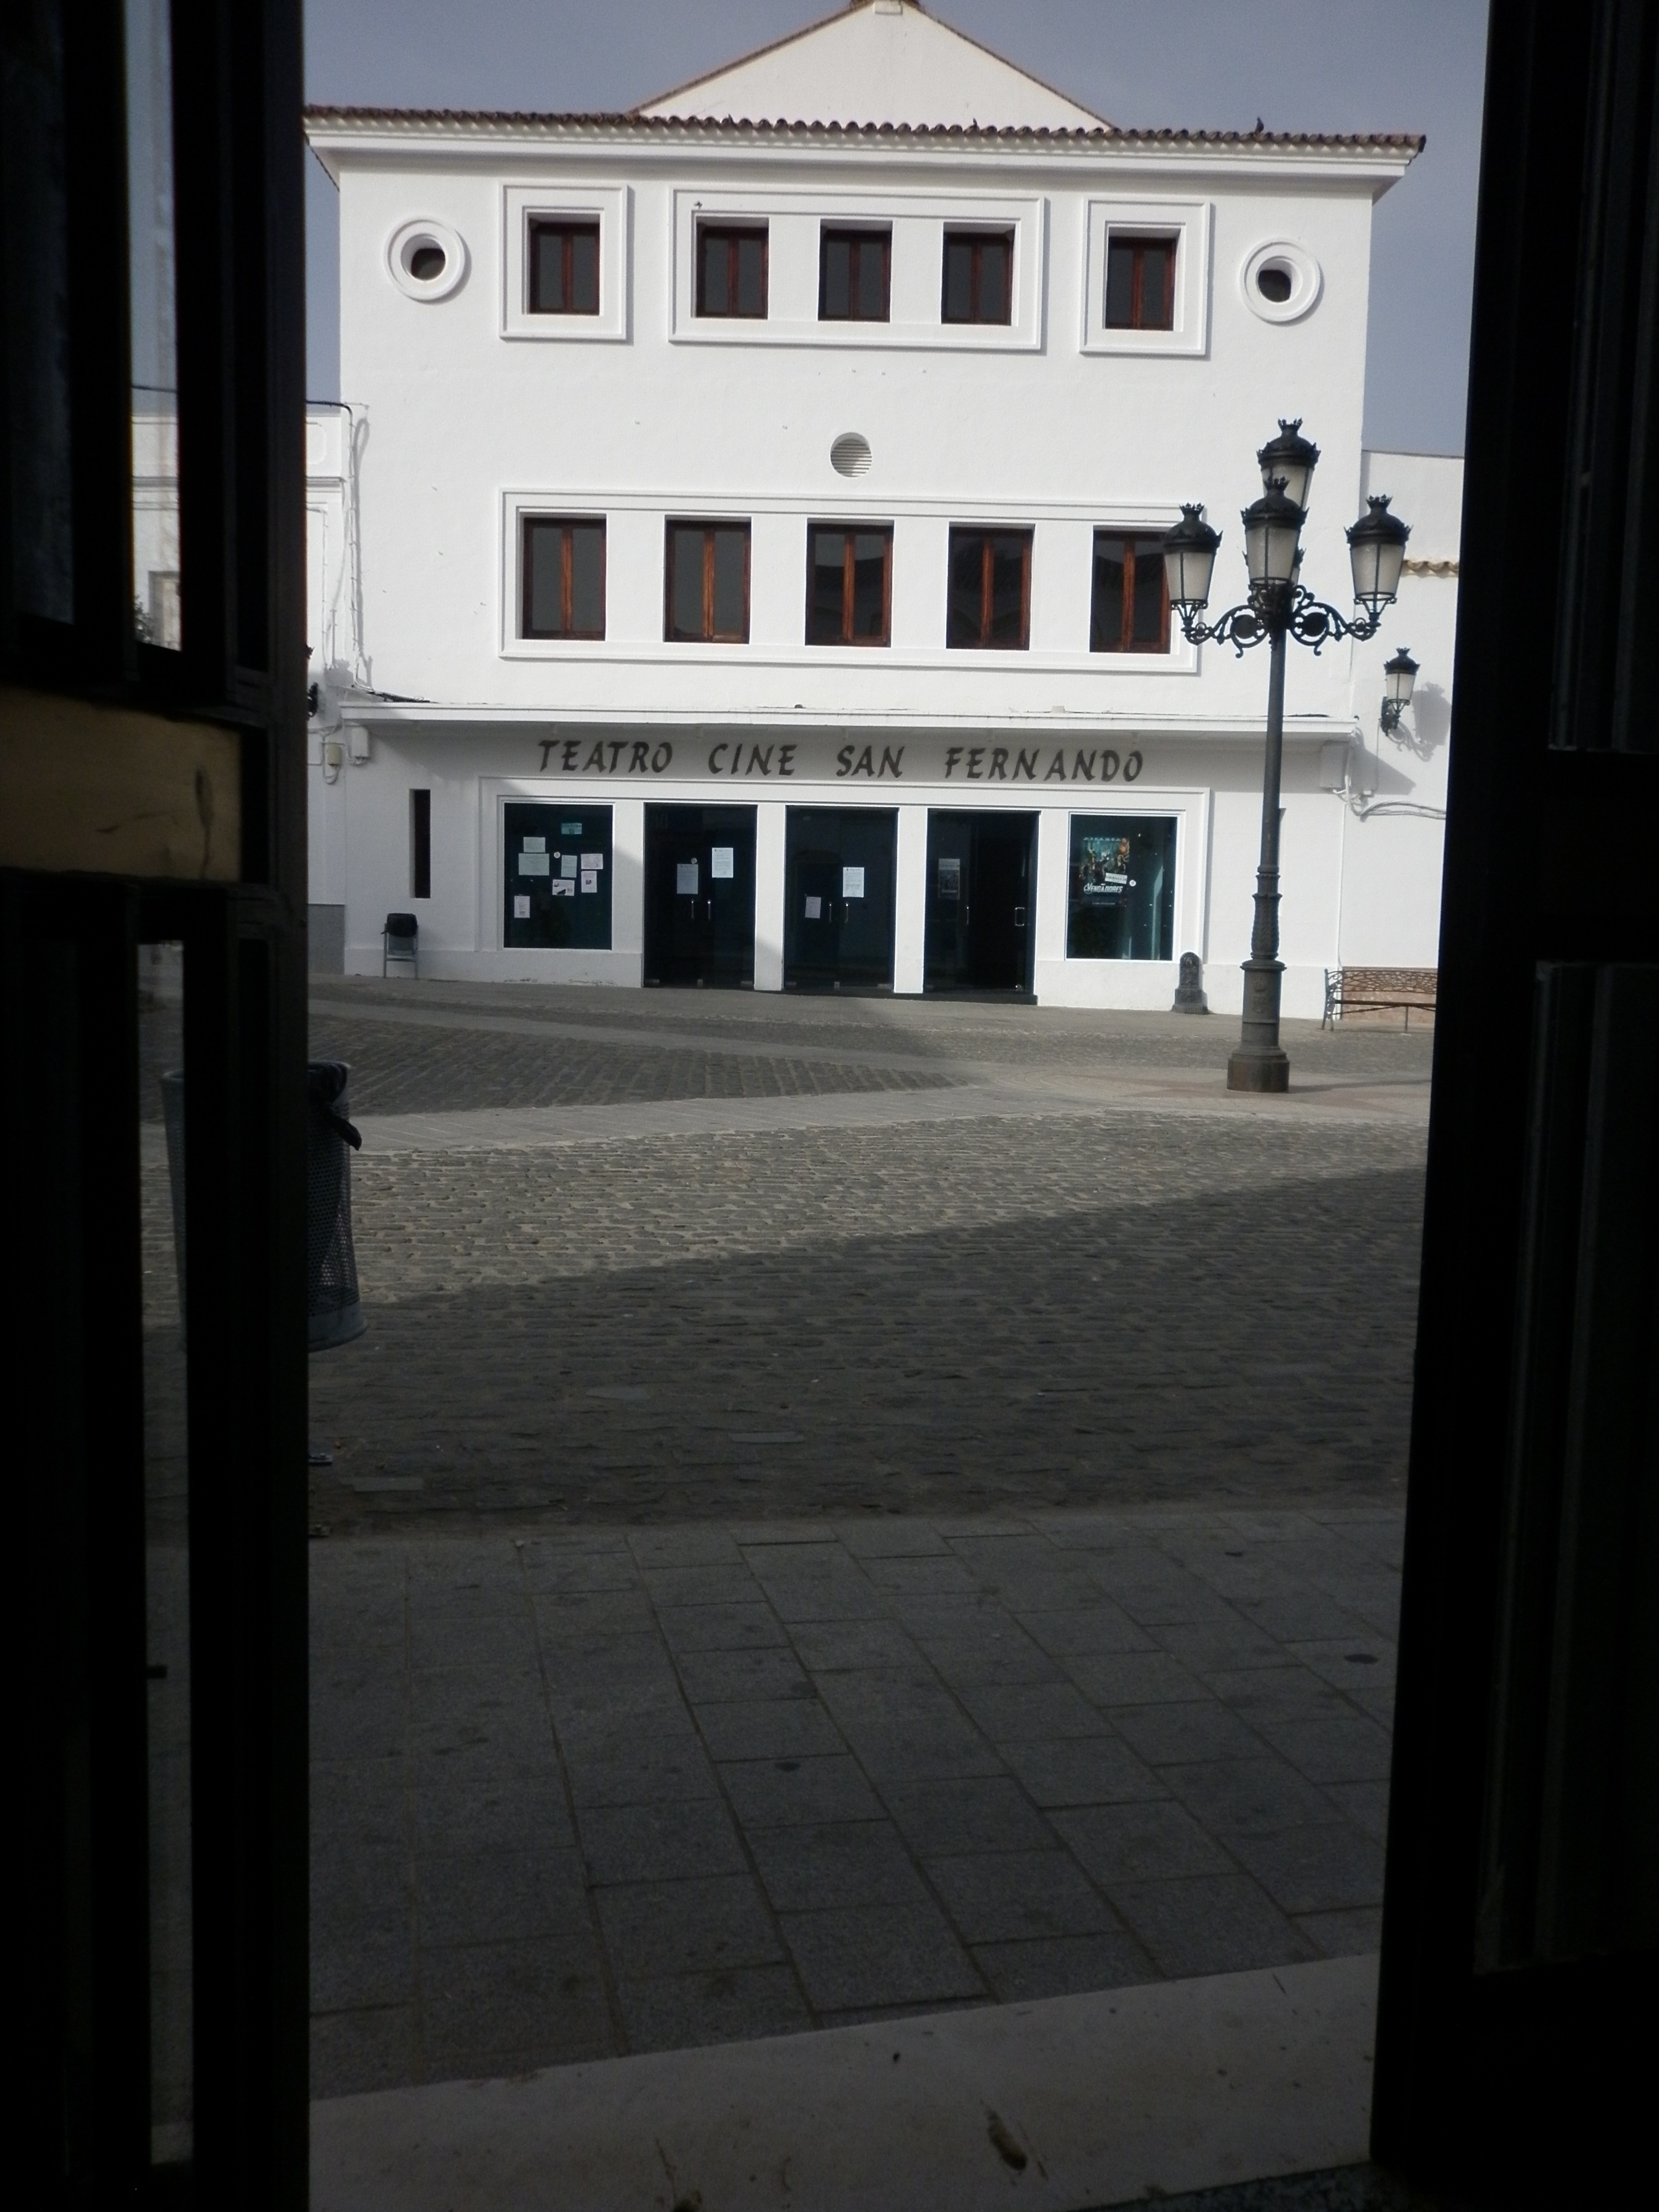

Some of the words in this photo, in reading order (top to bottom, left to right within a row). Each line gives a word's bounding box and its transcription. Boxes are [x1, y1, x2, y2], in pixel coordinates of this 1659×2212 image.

[538, 740, 673, 774] TEATRO
[708, 743, 797, 776] CINE
[836, 745, 905, 778] SAN
[945, 747, 1144, 782] FERNANDO
